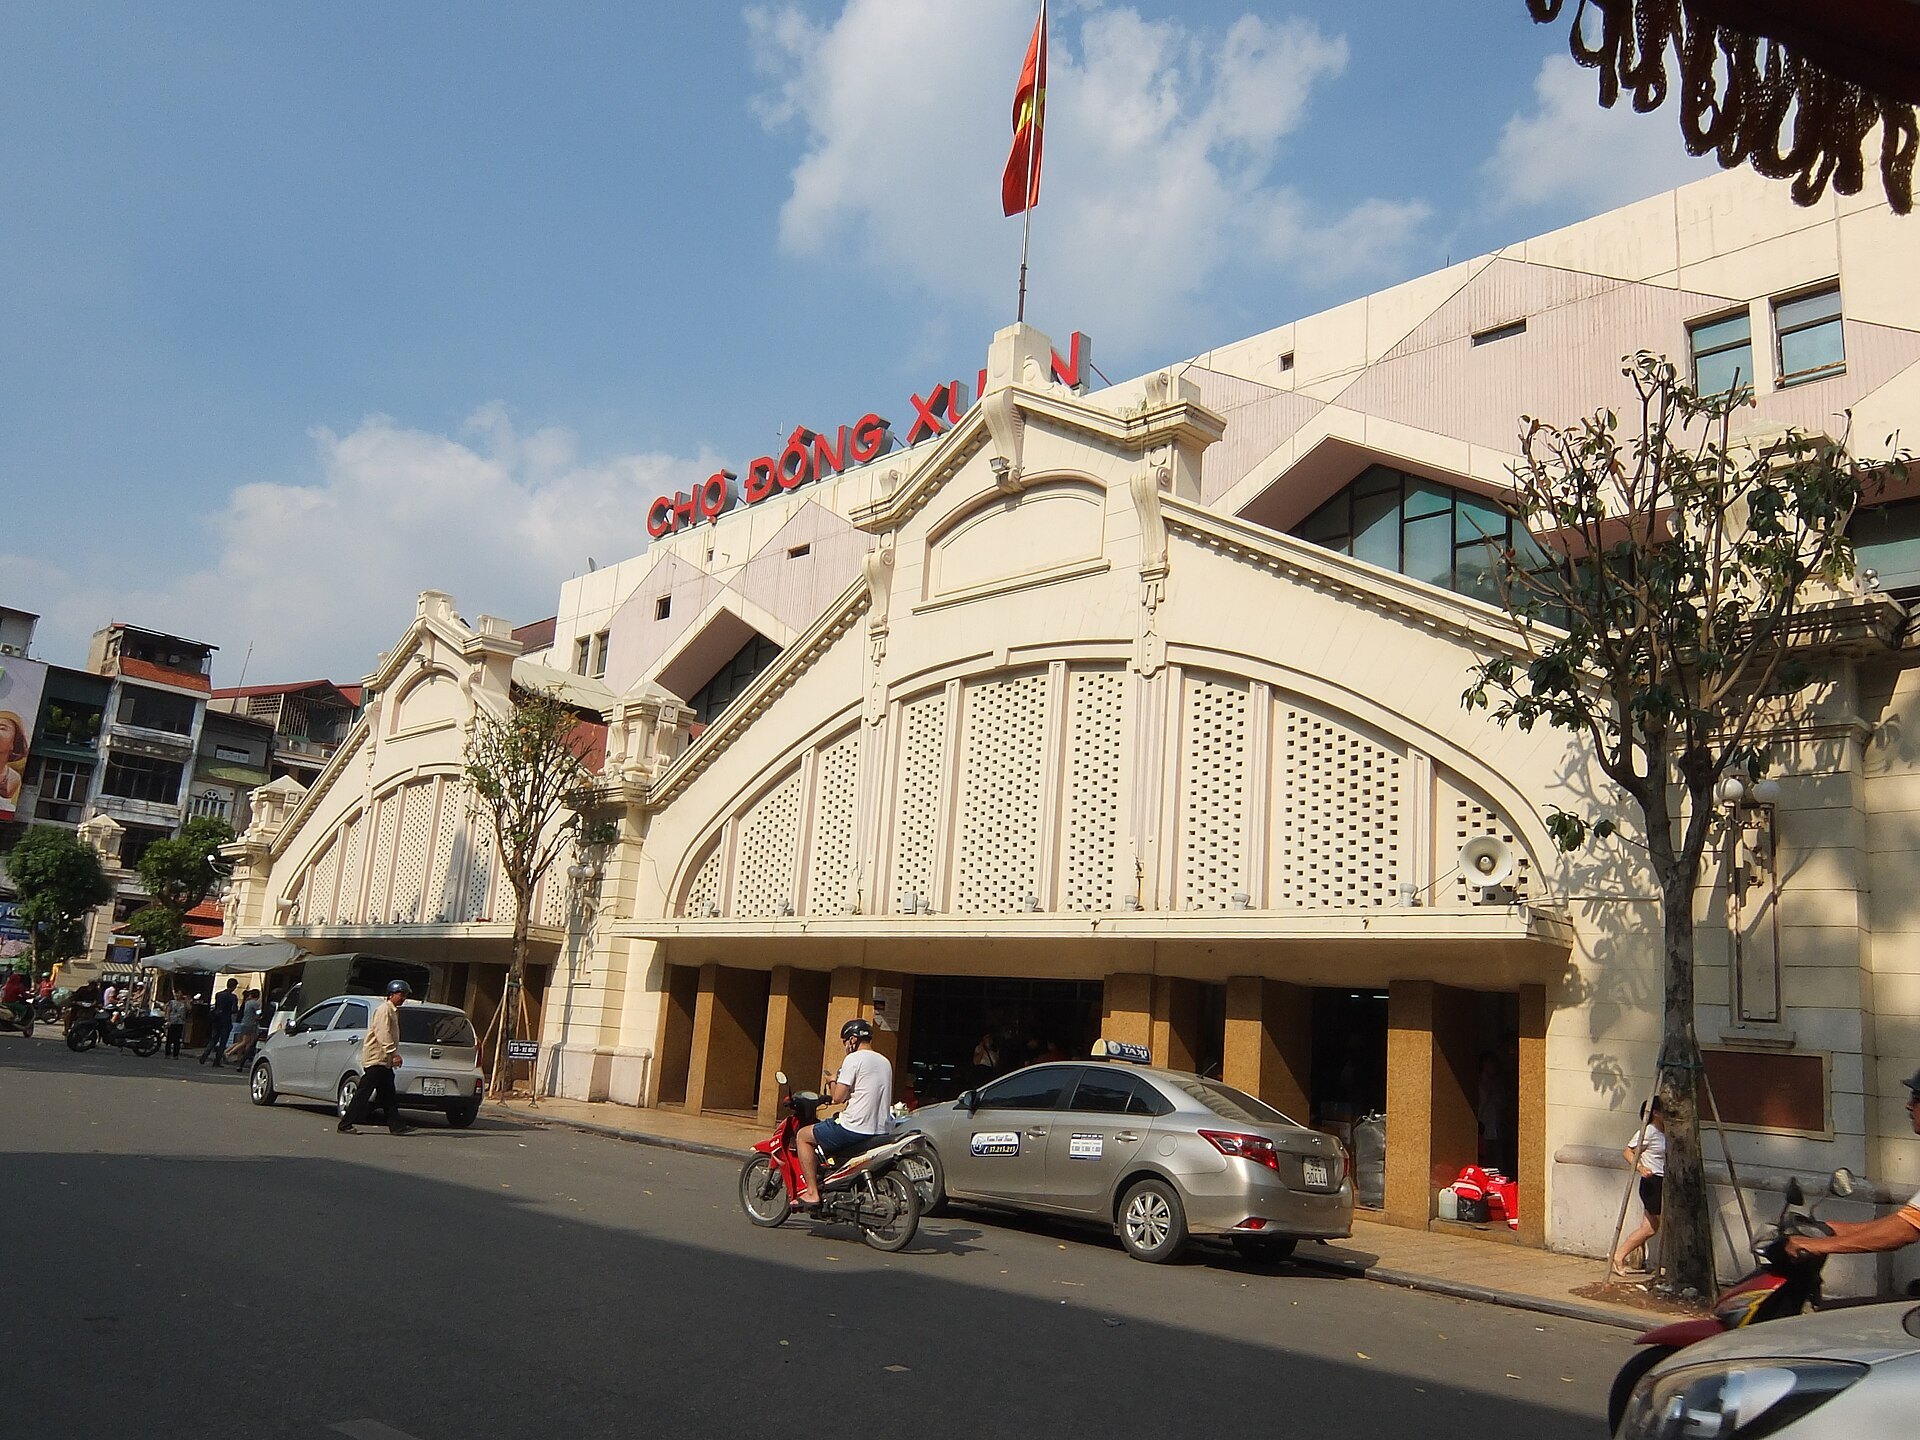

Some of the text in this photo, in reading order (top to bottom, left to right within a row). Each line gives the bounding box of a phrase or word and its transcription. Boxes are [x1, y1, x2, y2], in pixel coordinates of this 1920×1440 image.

[647, 469, 733, 538] CHỢ
[906, 331, 1085, 445] XUN
[1122, 1047, 1148, 1059] TAXI
